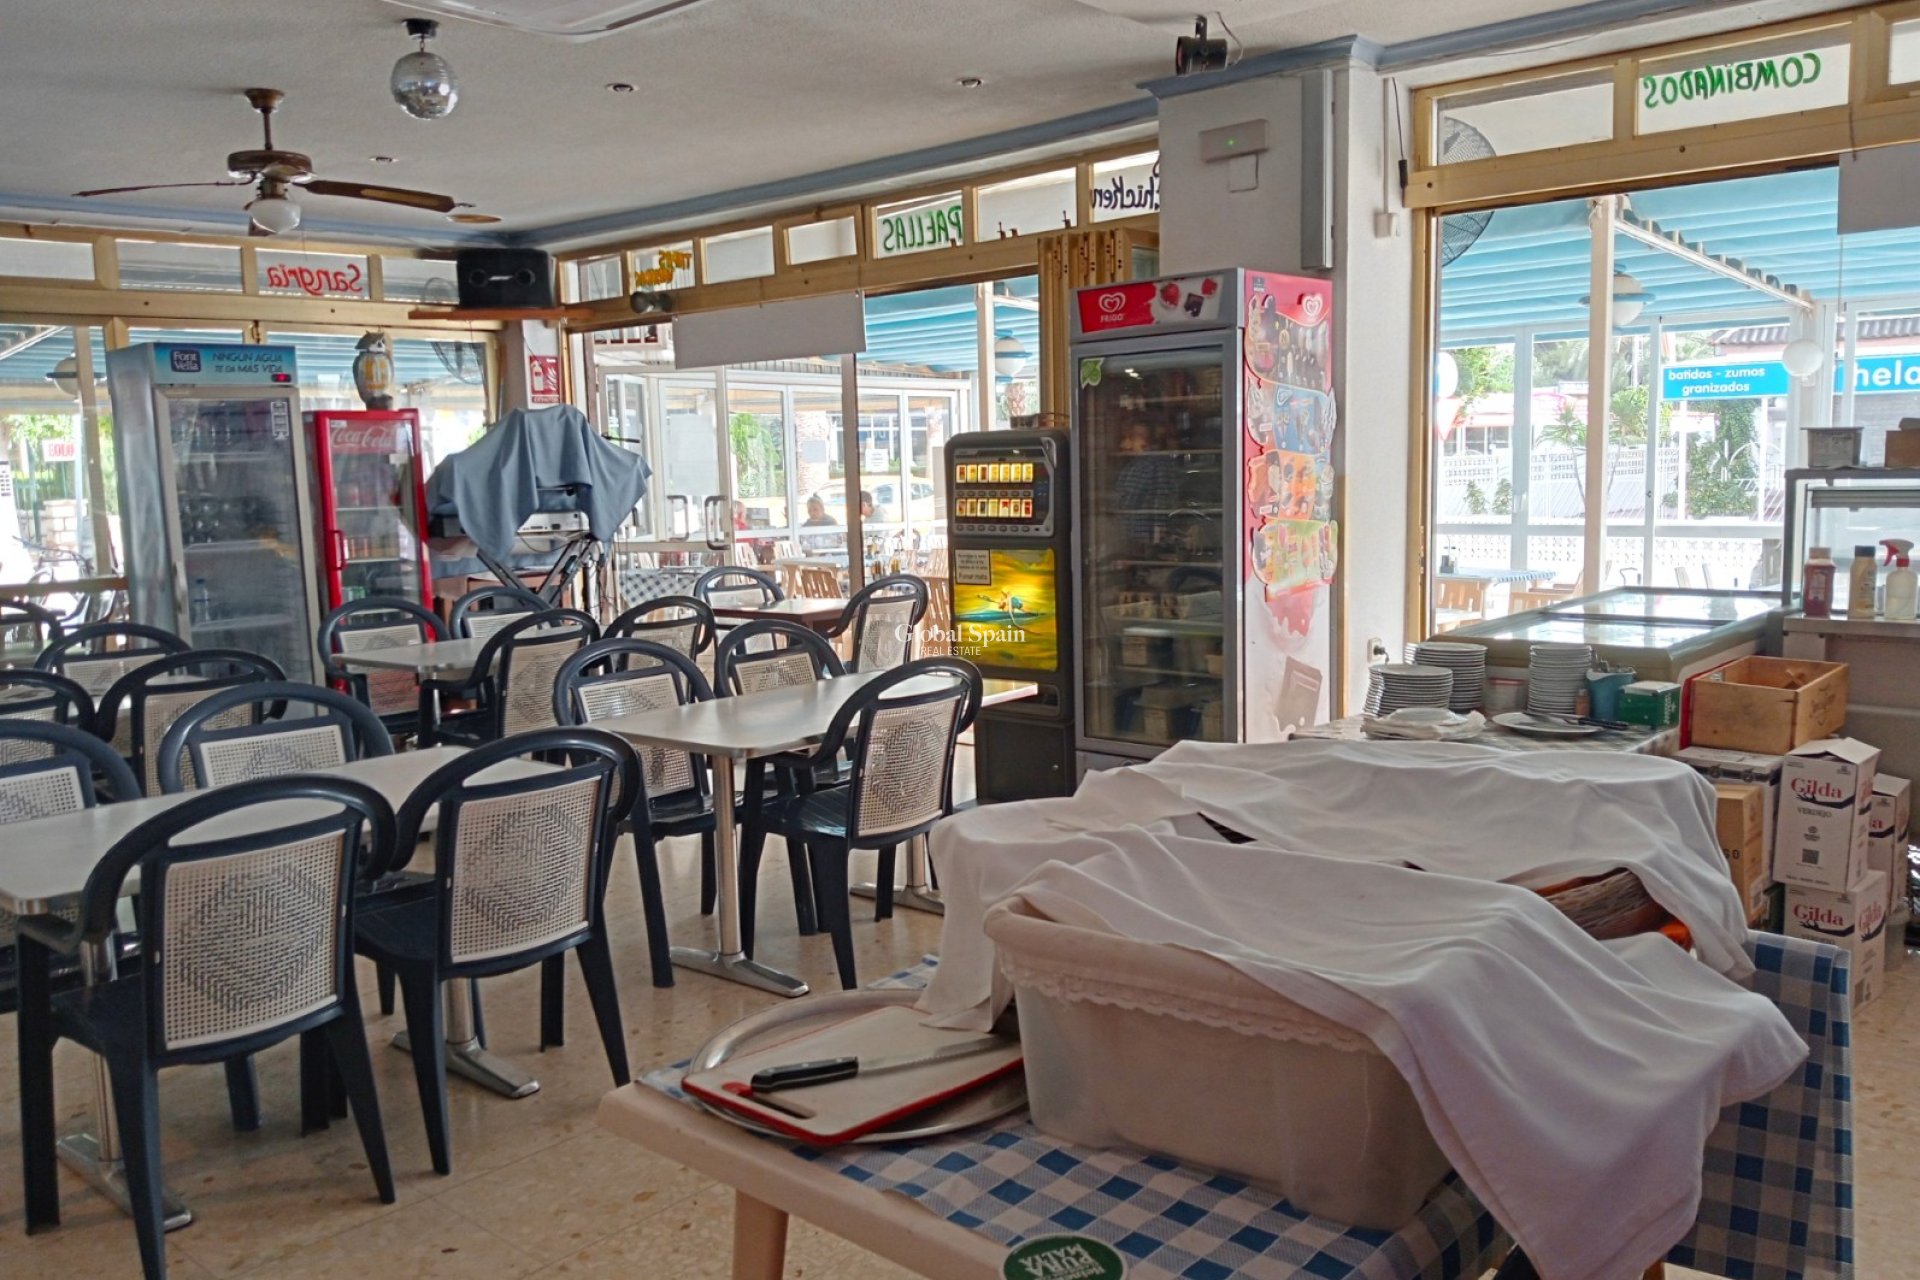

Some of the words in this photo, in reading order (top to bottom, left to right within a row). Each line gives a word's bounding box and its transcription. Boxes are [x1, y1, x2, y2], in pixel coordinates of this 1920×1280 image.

[173, 351, 197, 361] Font
[174, 361, 200, 370] Vella
[1668, 368, 1713, 380] batidos
[1725, 367, 1766, 378] zumos
[1682, 382, 1750, 396] granizados
[1791, 777, 1842, 799] Gilda
[1793, 903, 1844, 927] Gilda
